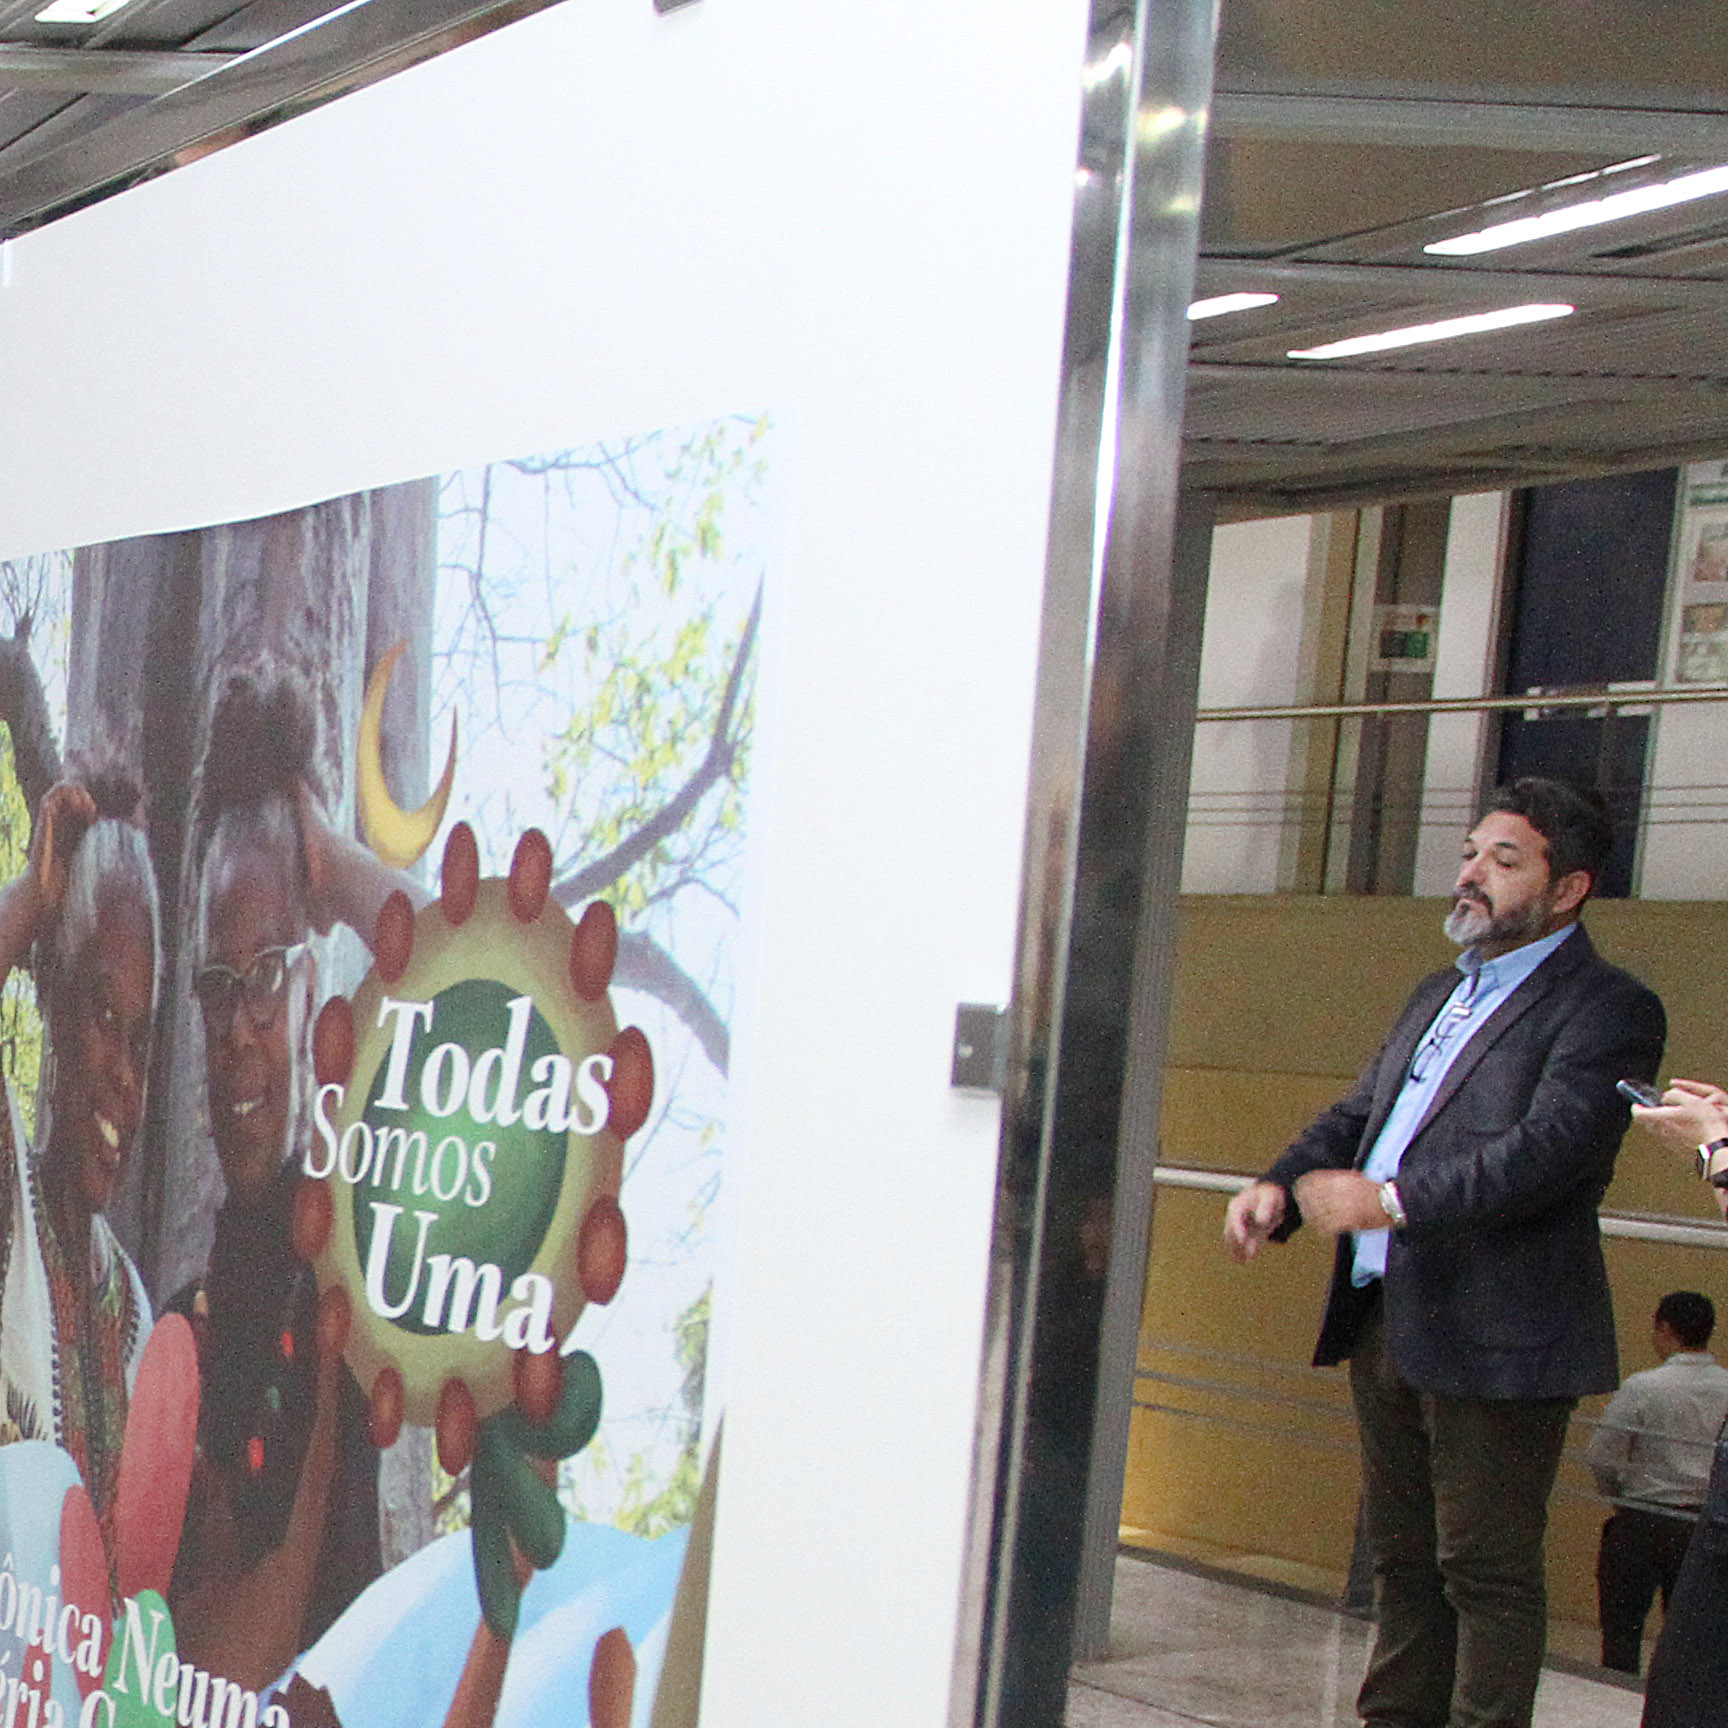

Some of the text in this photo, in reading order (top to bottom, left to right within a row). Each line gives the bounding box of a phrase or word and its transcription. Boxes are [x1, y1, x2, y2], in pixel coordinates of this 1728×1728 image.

[371, 994, 613, 1138] Todas
[304, 1083, 495, 1208] Somos
[365, 1201, 557, 1355] Uma
